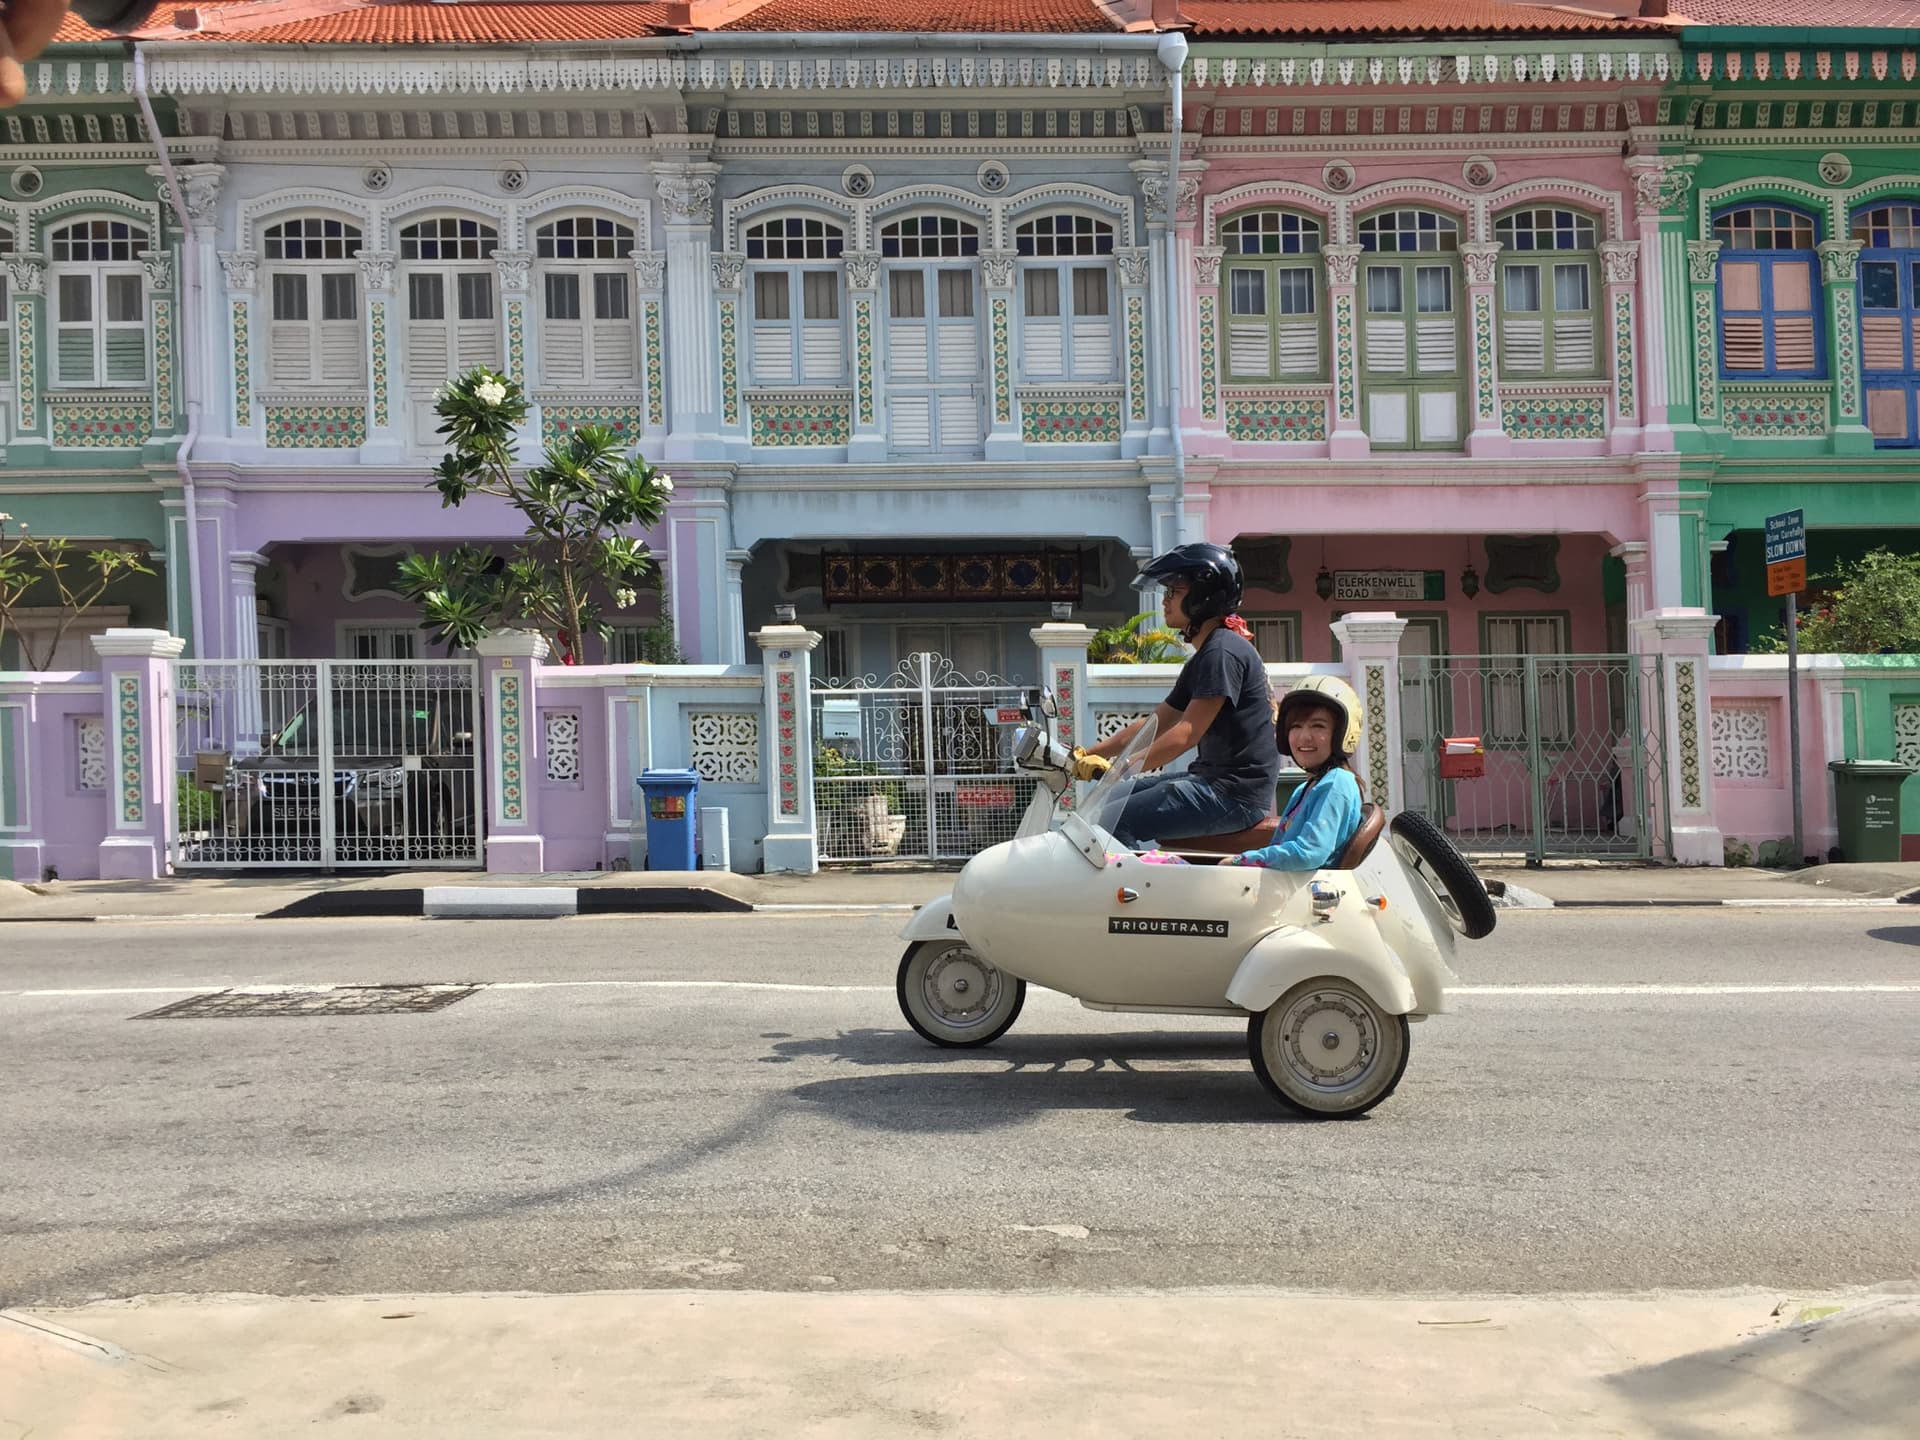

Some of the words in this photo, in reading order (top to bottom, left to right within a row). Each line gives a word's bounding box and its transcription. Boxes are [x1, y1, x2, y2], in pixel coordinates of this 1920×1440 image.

[1769, 518, 1786, 530] School
[1767, 543, 1784, 558] SLOW
[1785, 538, 1806, 554] DOWN
[1337, 577, 1417, 587] CLERKENWELL
[1337, 588, 1369, 598] ROAD
[274, 807, 295, 817] SLE
[298, 807, 321, 817] 704
[1112, 920, 1226, 934] TRIQUETRA.SG
